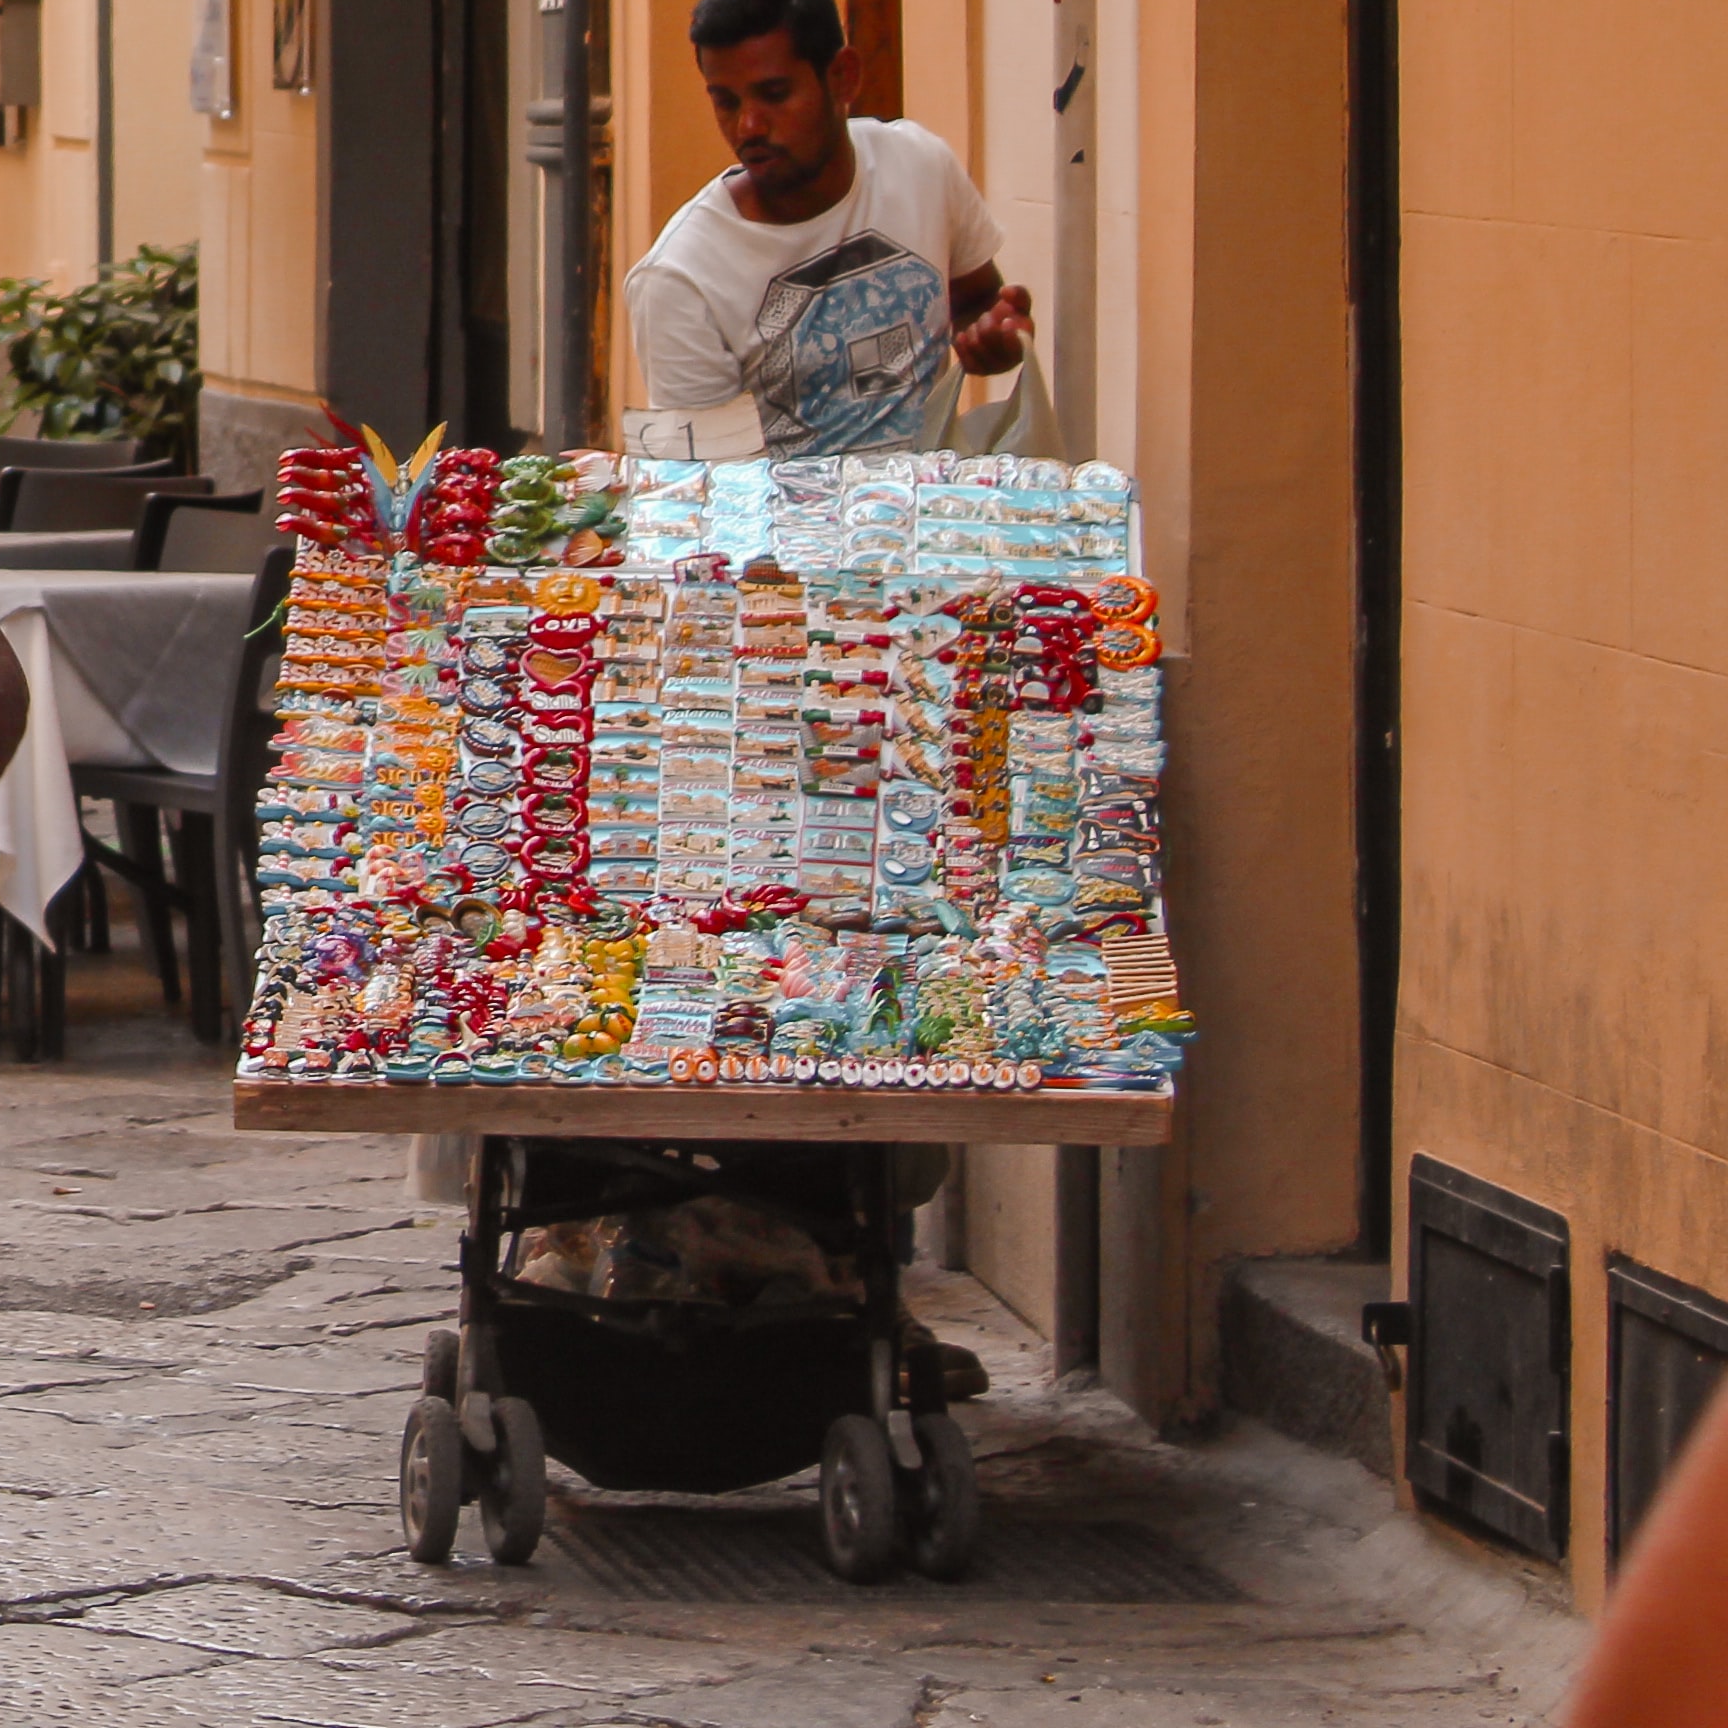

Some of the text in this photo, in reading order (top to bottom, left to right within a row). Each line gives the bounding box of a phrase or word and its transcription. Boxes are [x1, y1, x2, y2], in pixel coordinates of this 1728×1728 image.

[530, 618, 591, 633] LOVE
[532, 691, 582, 710] Sicilia
[535, 725, 585, 743] Sicilia
